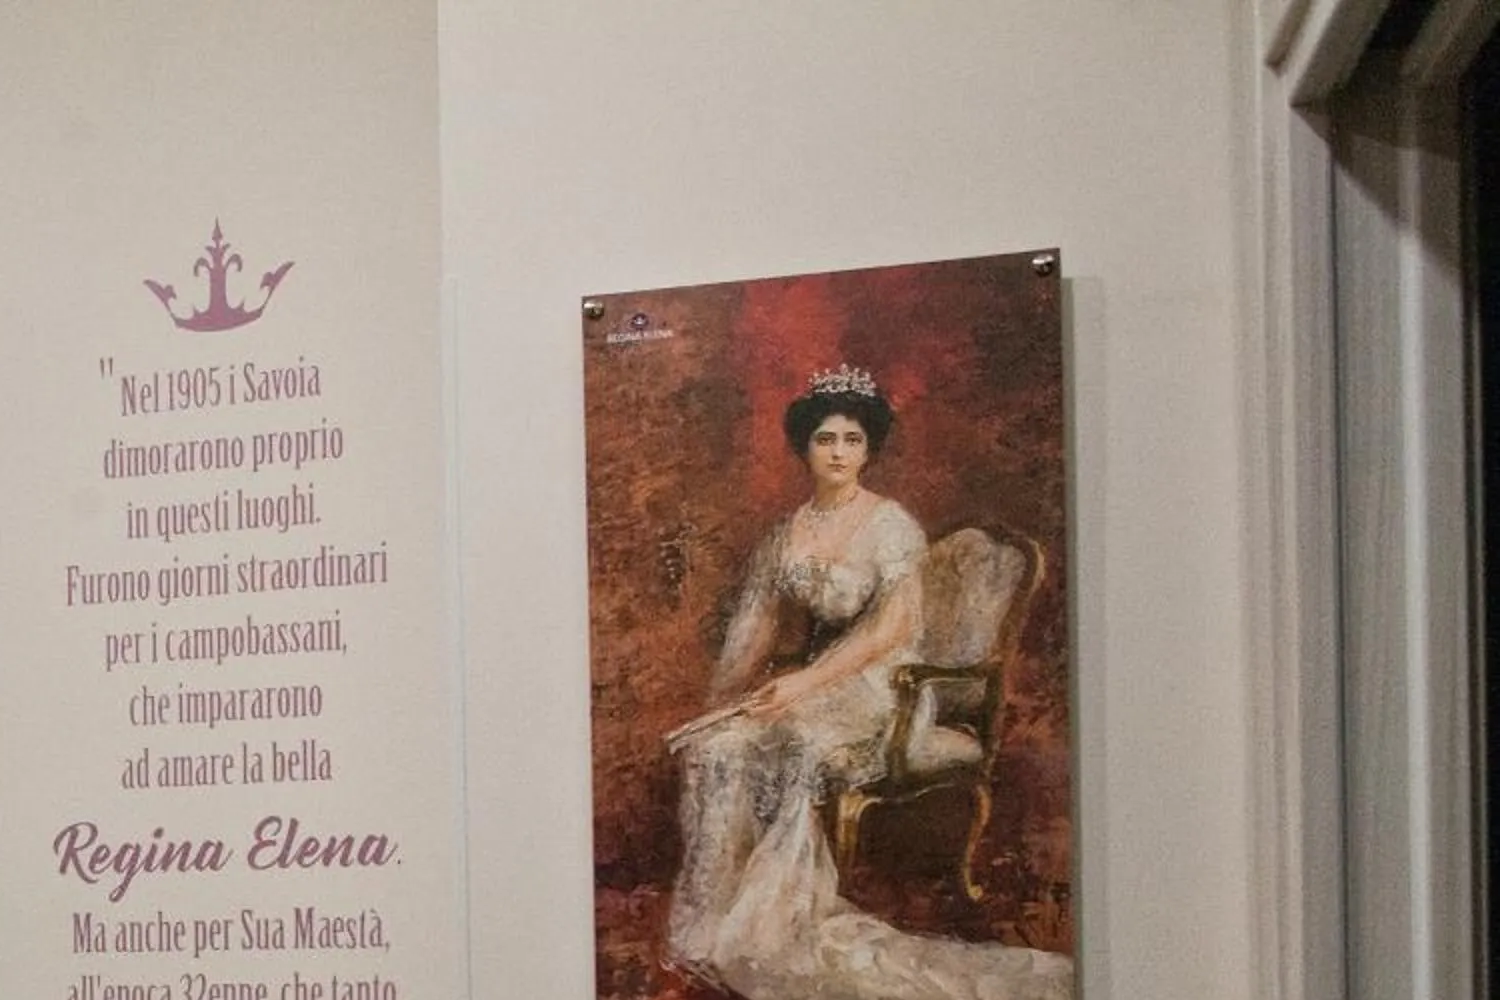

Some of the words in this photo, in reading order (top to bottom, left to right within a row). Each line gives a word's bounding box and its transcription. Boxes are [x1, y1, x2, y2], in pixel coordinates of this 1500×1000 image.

[167, 366, 222, 411] 1905
[229, 364, 236, 405] i
[243, 355, 321, 403] Savoia
[103, 437, 245, 479] dimorarono
[252, 417, 344, 473] proprio
[127, 501, 149, 540] in
[156, 490, 230, 544] questi
[237, 482, 322, 534] luoghi.
[66, 564, 151, 607] Furono
[157, 553, 229, 607] giorni
[237, 540, 388, 593] straordinari
[105, 633, 144, 673] per
[151, 622, 158, 664] i
[165, 609, 347, 666] campobassani,
[129, 685, 171, 727] che
[177, 682, 323, 730] impararono
[121, 747, 150, 790] ad
[157, 753, 235, 788] amare
[242, 742, 264, 785] la
[271, 738, 333, 783] bella
[52, 821, 234, 904] Regina
[246, 815, 402, 871] Elena.
[72, 911, 107, 954] Ma
[114, 910, 187, 953] anche
[193, 919, 234, 959] per
[240, 908, 286, 951] Sua
[293, 906, 391, 951] Maestà,
